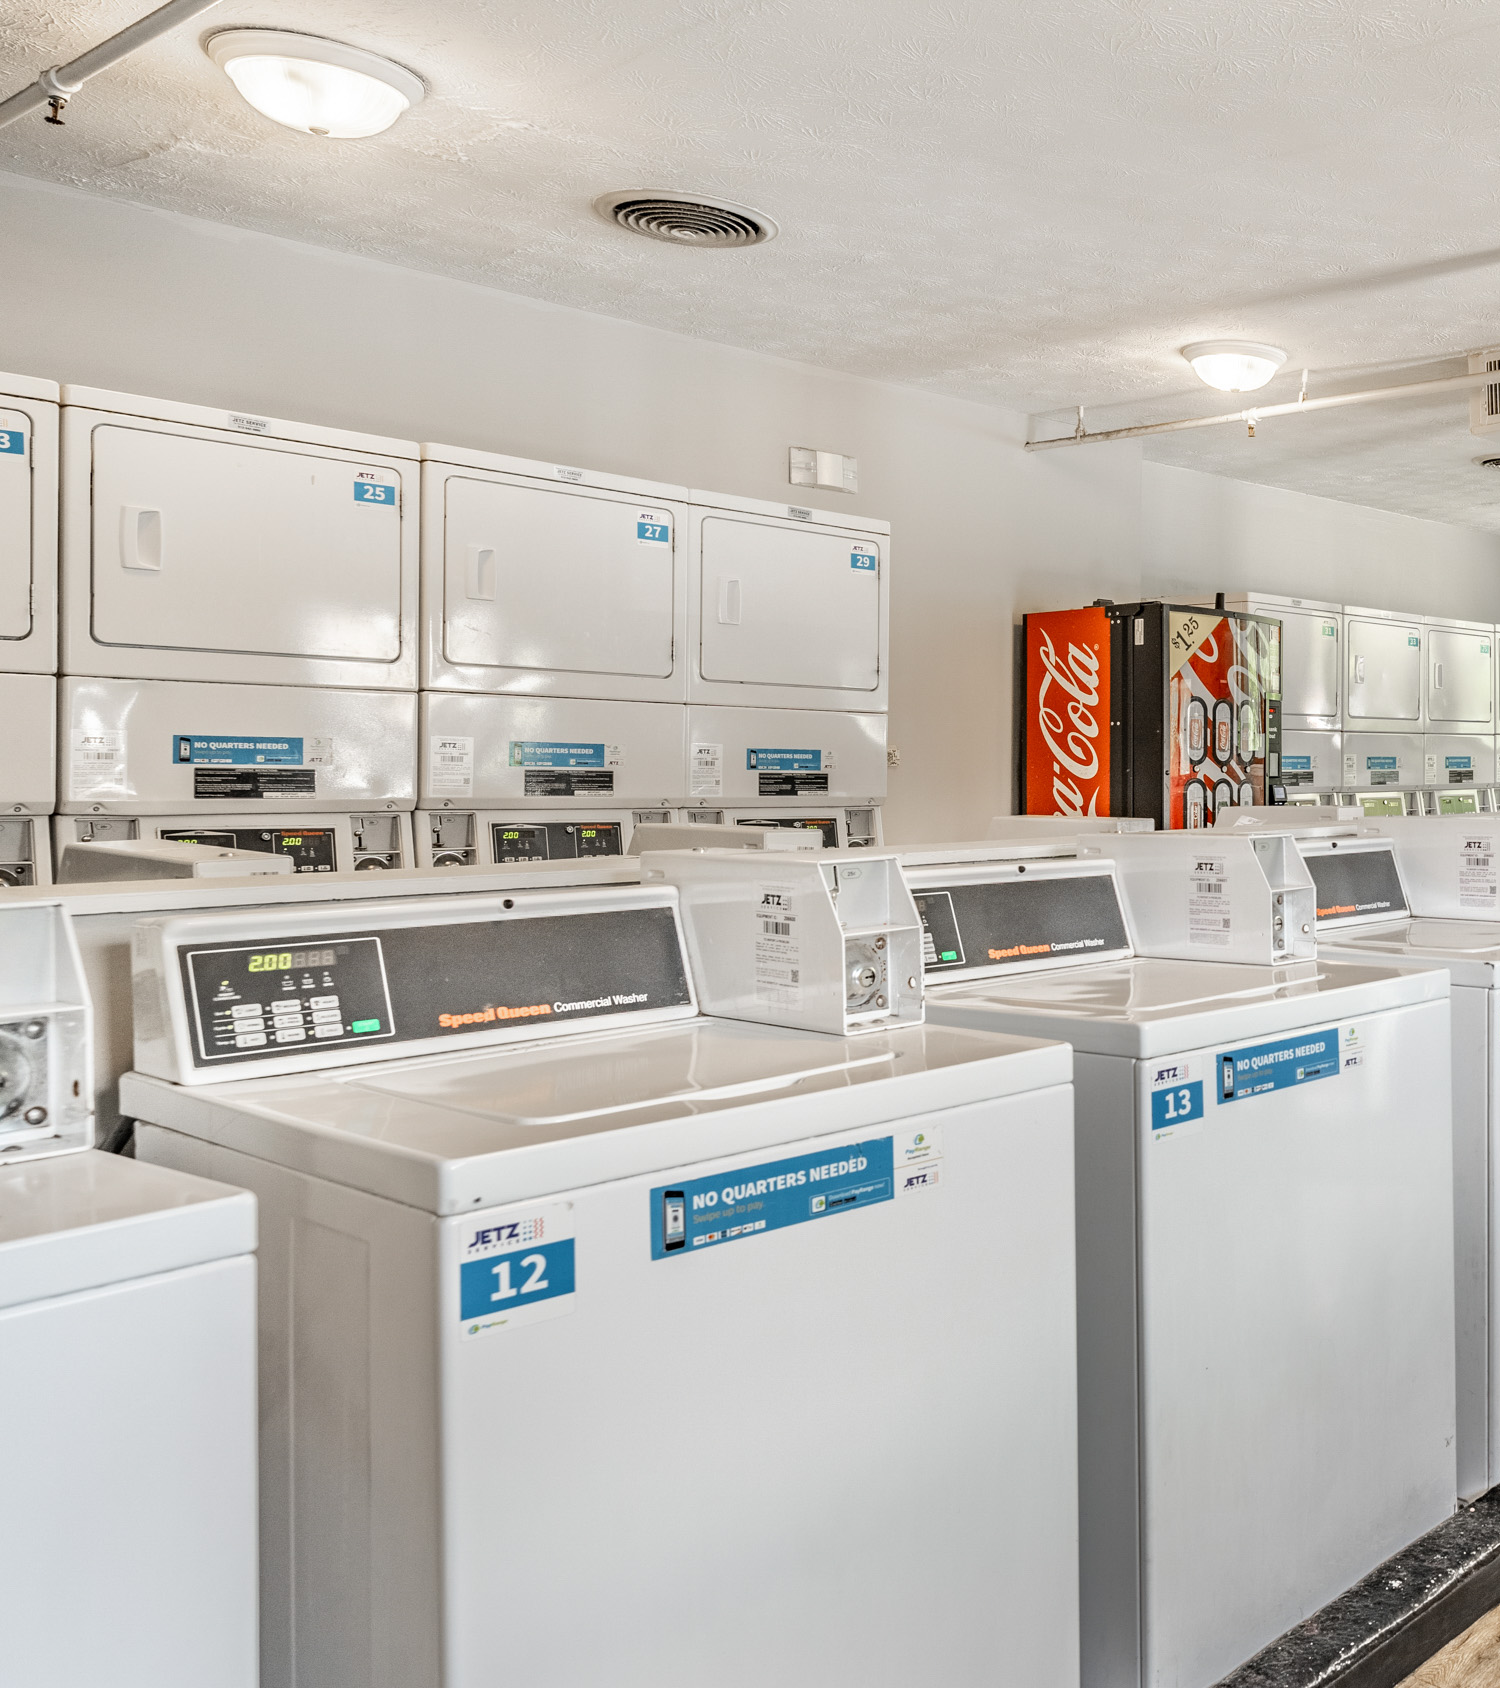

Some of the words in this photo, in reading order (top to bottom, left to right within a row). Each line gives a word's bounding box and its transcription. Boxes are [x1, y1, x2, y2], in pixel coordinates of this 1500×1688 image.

[0, 432, 10, 449] 3
[357, 472, 375, 480] JETZ
[363, 485, 385, 501] 25
[644, 525, 662, 538] 27
[856, 556, 870, 568] 29
[209, 742, 255, 750] QUARTERS
[582, 830, 596, 838] 2.00
[282, 837, 302, 846] 2.00
[1195, 862, 1214, 871] JETZ
[762, 894, 782, 906] JETZ
[988, 946, 1019, 960] Speed
[1020, 944, 1050, 955] Queen
[1051, 940, 1084, 951] Commercial
[1084, 938, 1105, 947] Washer
[248, 953, 292, 972] 2.00
[438, 1008, 496, 1029] Speed
[497, 1004, 551, 1020] Queen
[554, 996, 612, 1013] Commercial
[612, 992, 648, 1005] Washer
[1237, 1059, 1250, 1072] NO
[1251, 1050, 1294, 1070] QUARTERS
[1295, 1042, 1326, 1058] NEEDED
[1345, 1058, 1358, 1067] JETZ
[1155, 1067, 1178, 1082] JETZ
[1165, 1089, 1192, 1120] 13
[905, 1146, 931, 1155] PayRange
[693, 1191, 718, 1210] NO
[721, 1170, 807, 1205] QUARTERS
[810, 1157, 868, 1183] NEEDED
[904, 1174, 928, 1188] JETZ
[852, 1186, 874, 1196] PayRange
[693, 1210, 721, 1224] Swipe
[722, 1207, 735, 1218] up
[736, 1204, 746, 1213] to
[468, 1222, 520, 1249] JETZ
[490, 1253, 550, 1302] 12
